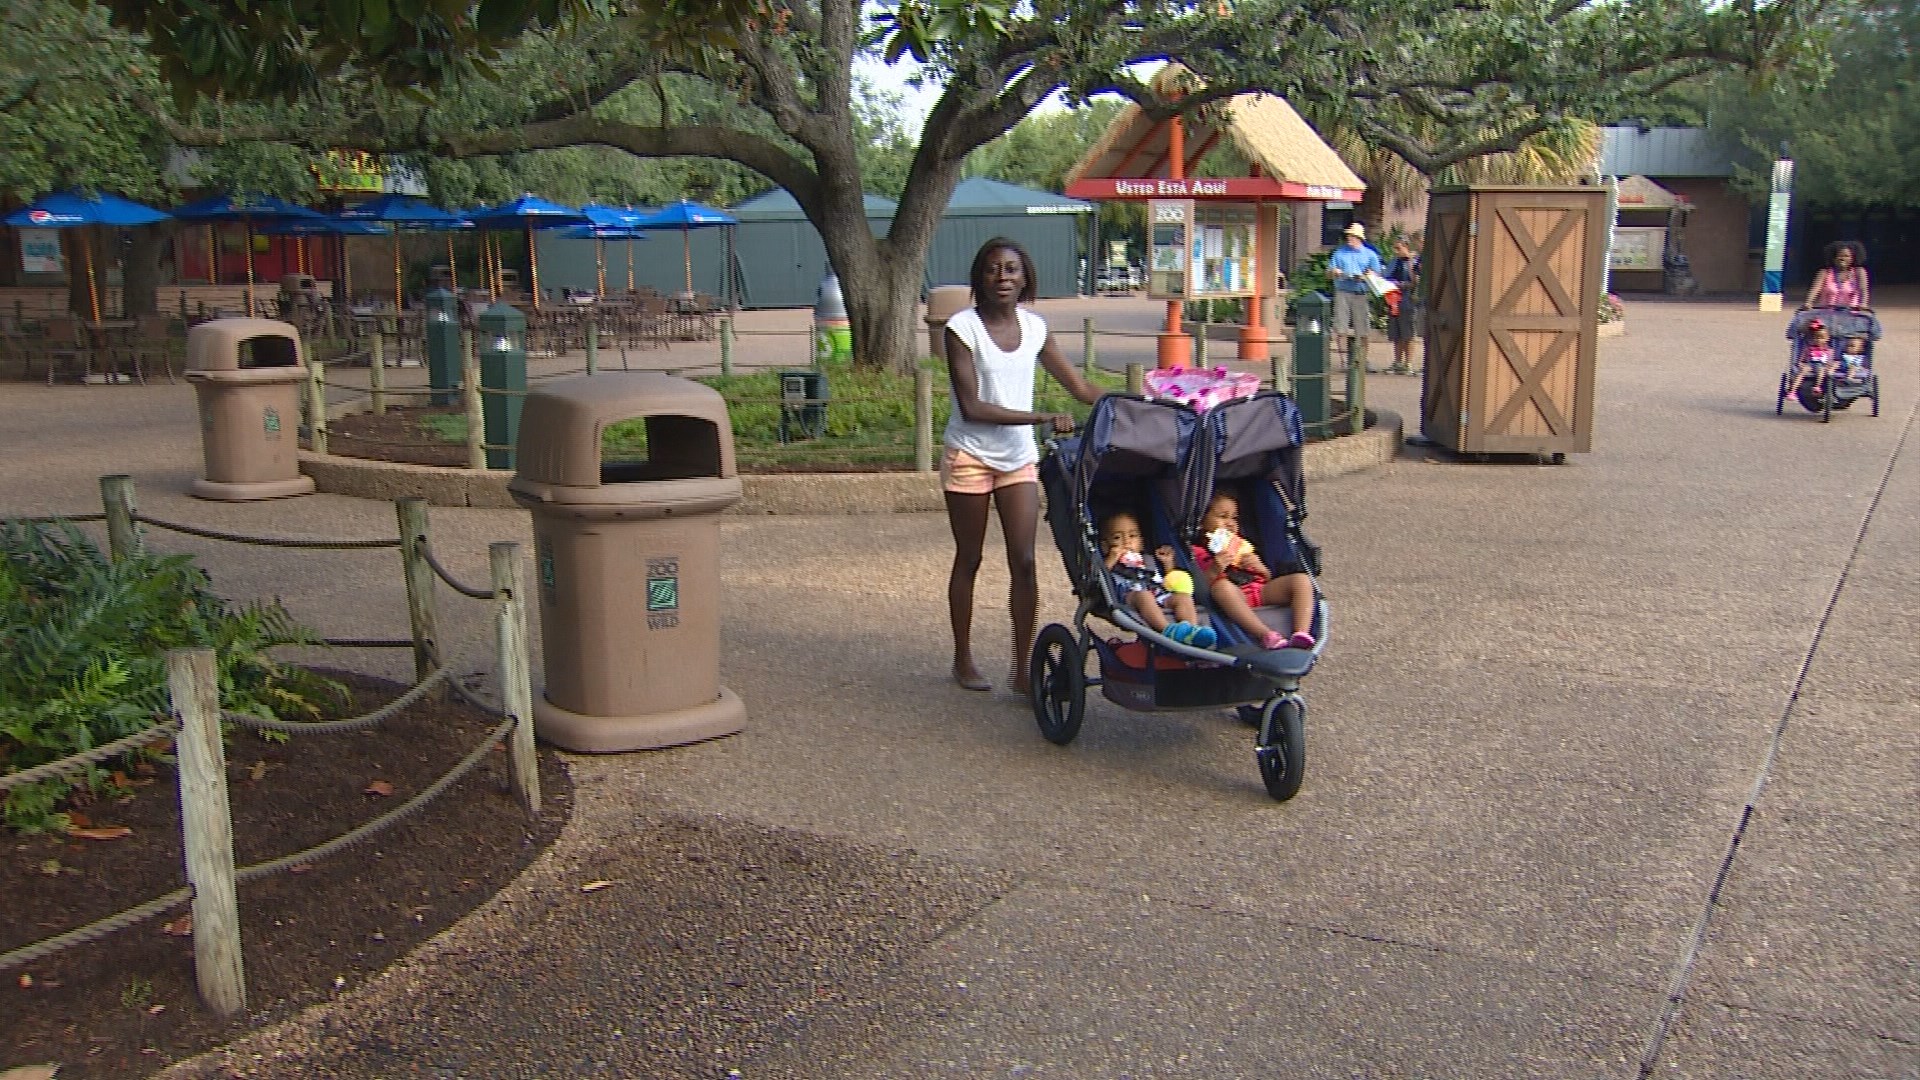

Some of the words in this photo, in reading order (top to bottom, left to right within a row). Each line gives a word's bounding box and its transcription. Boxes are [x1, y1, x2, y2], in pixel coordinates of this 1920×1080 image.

[1155, 208, 1185, 222] ZOO
[646, 561, 679, 577] ZOO
[647, 615, 680, 631] WILD
